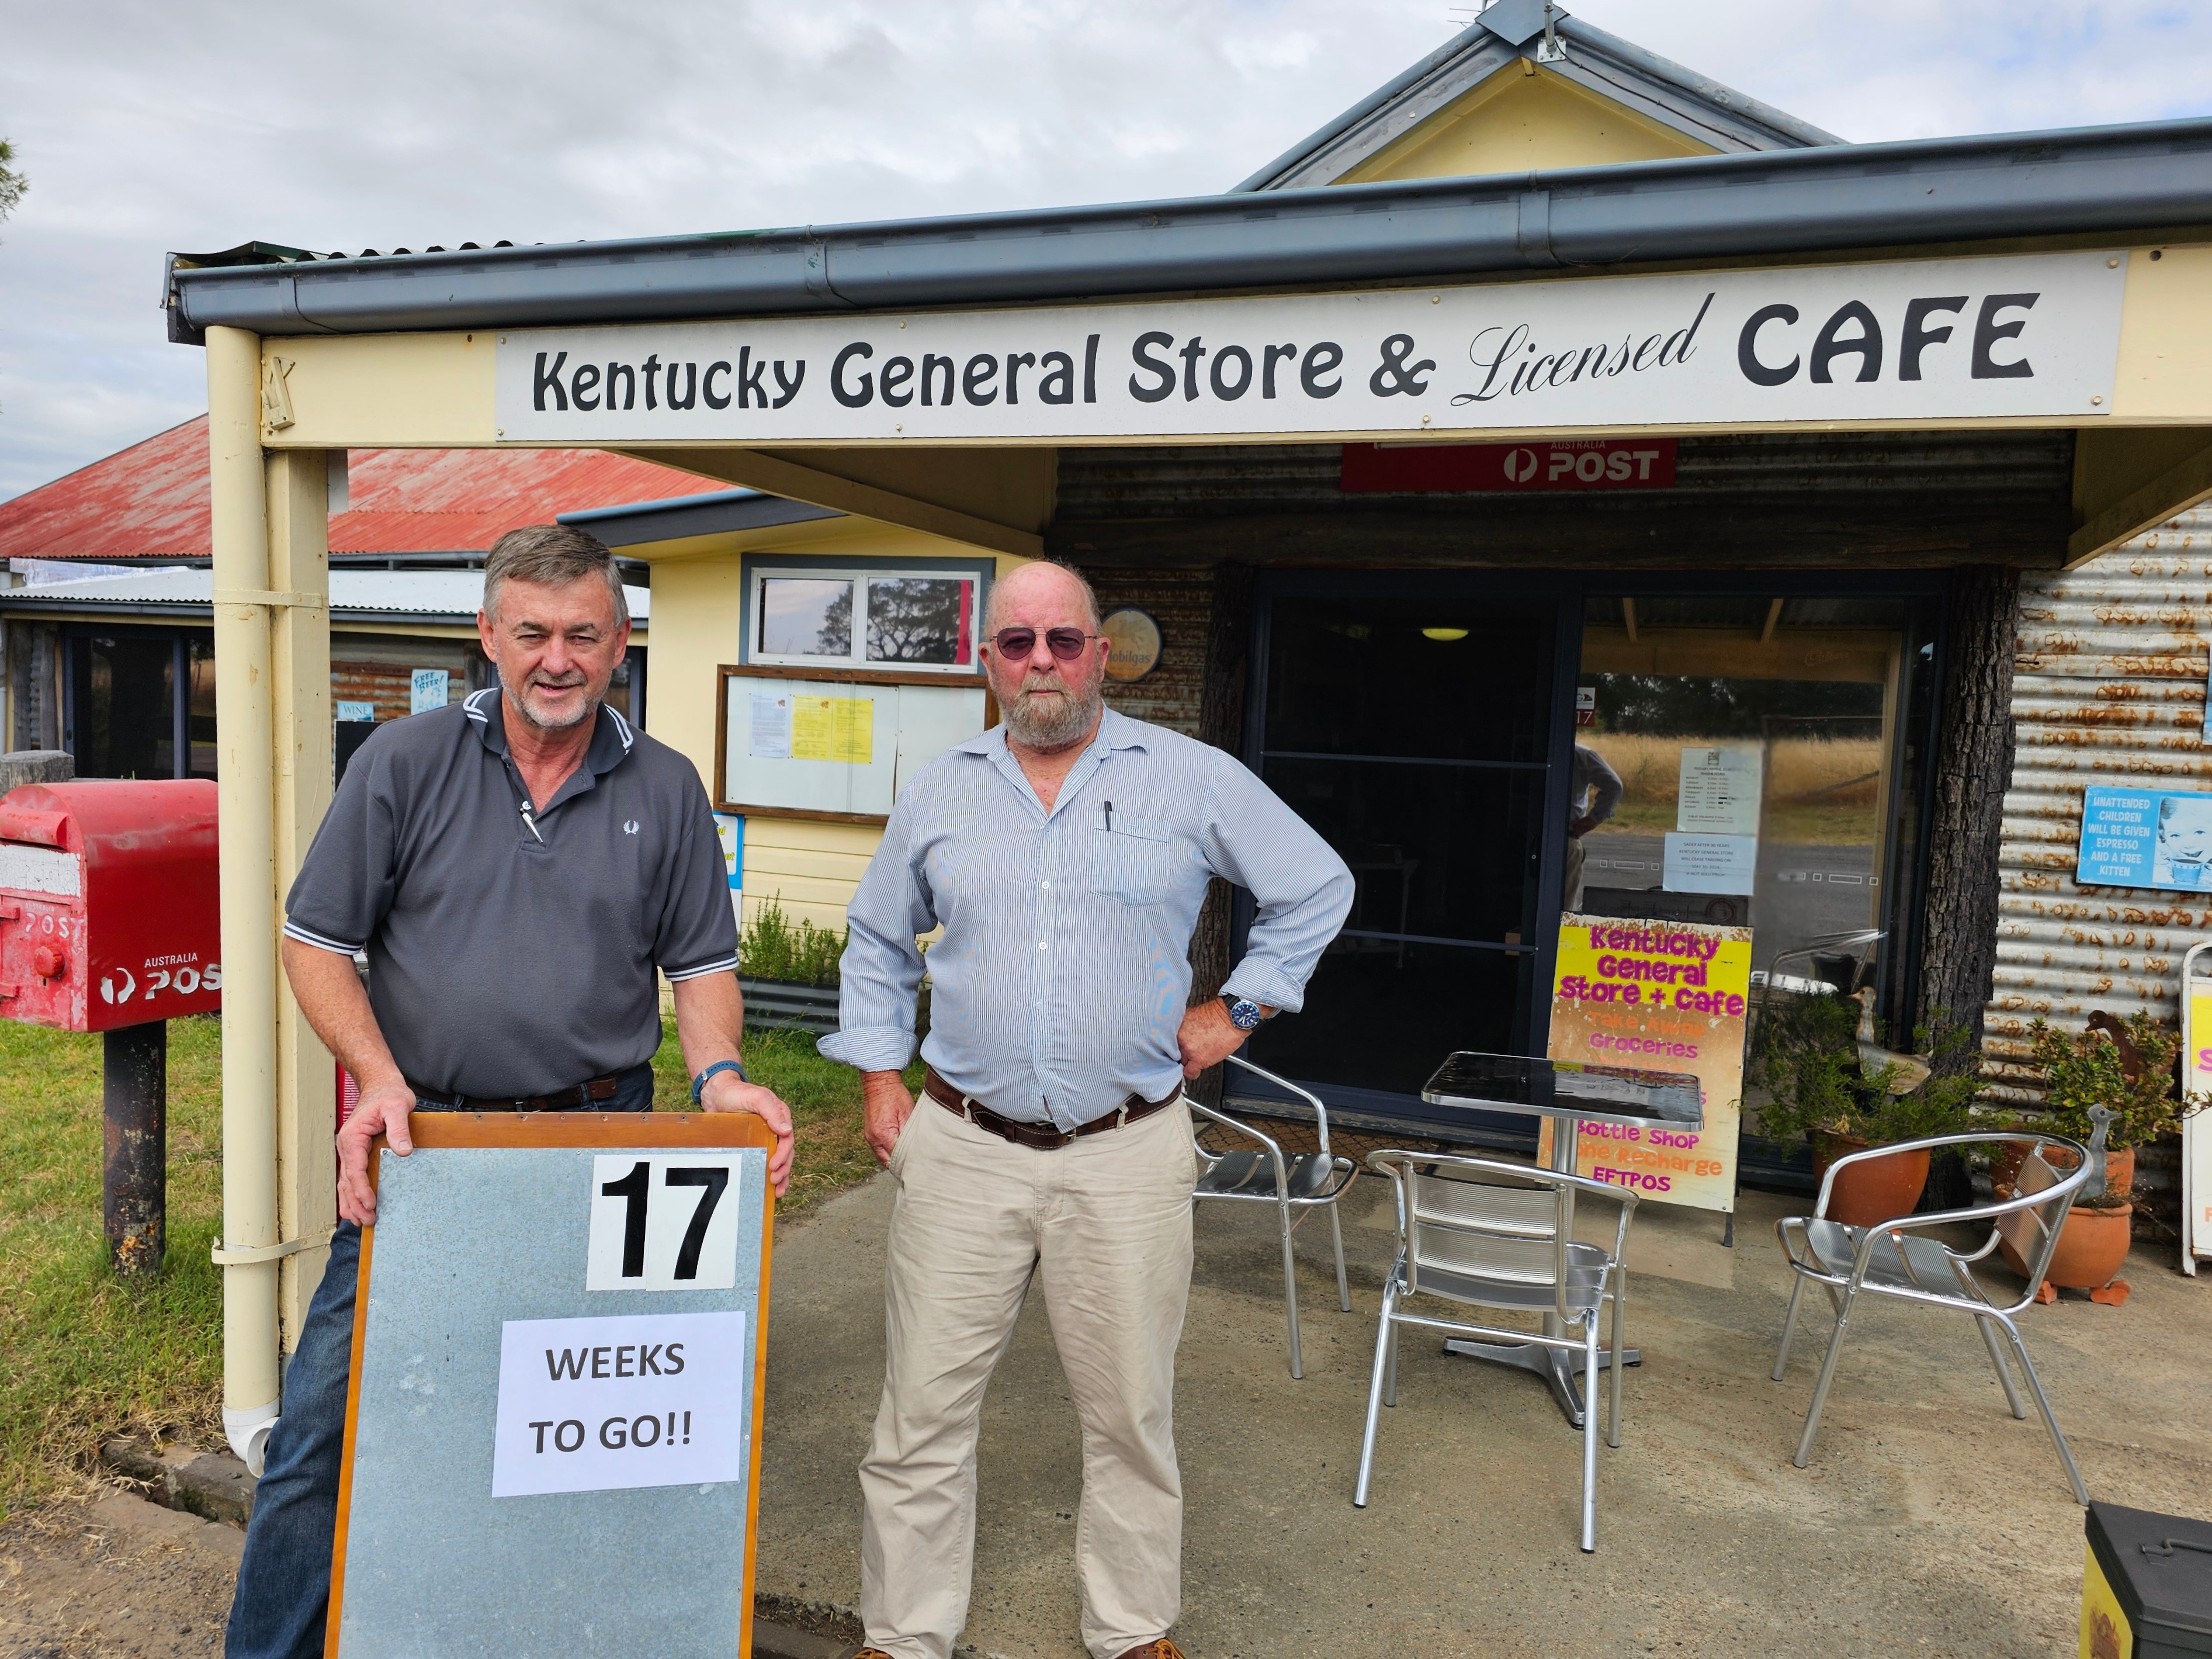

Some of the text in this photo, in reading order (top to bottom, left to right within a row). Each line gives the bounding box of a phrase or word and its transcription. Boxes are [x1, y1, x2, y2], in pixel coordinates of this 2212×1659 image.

[533, 292, 2041, 411] Kentucky General Store & Licensed CAFE
[1550, 441, 1606, 449] AUSTRALIA
[1548, 451, 1659, 482] POST
[414, 671, 435, 688] FREE
[344, 705, 369, 715] WINE
[2093, 797, 2150, 809] UNATTENDED
[2099, 811, 2141, 823] CHILDREN
[2088, 823, 2150, 837] WILL BE GIVEN
[2096, 837, 2138, 850] ESPRESSO
[2090, 851, 2142, 864] AND A FREE
[2099, 865, 2130, 877] KITTEN
[1590, 925, 1721, 962] Kentucky
[144, 953, 197, 968] AUSTRALIA
[1597, 954, 1707, 986] General
[145, 964, 221, 1000] POS
[1559, 975, 1641, 1005] Store
[1649, 988, 1666, 1004] +
[1587, 1012, 1705, 1038] Take Away
[1590, 1033, 1698, 1058] Groceries
[1593, 1166, 1671, 1192] EFTPOS
[601, 1161, 729, 1280] 17
[546, 1343, 685, 1381] WEEKS
[529, 1411, 691, 1454] TO GO!!
